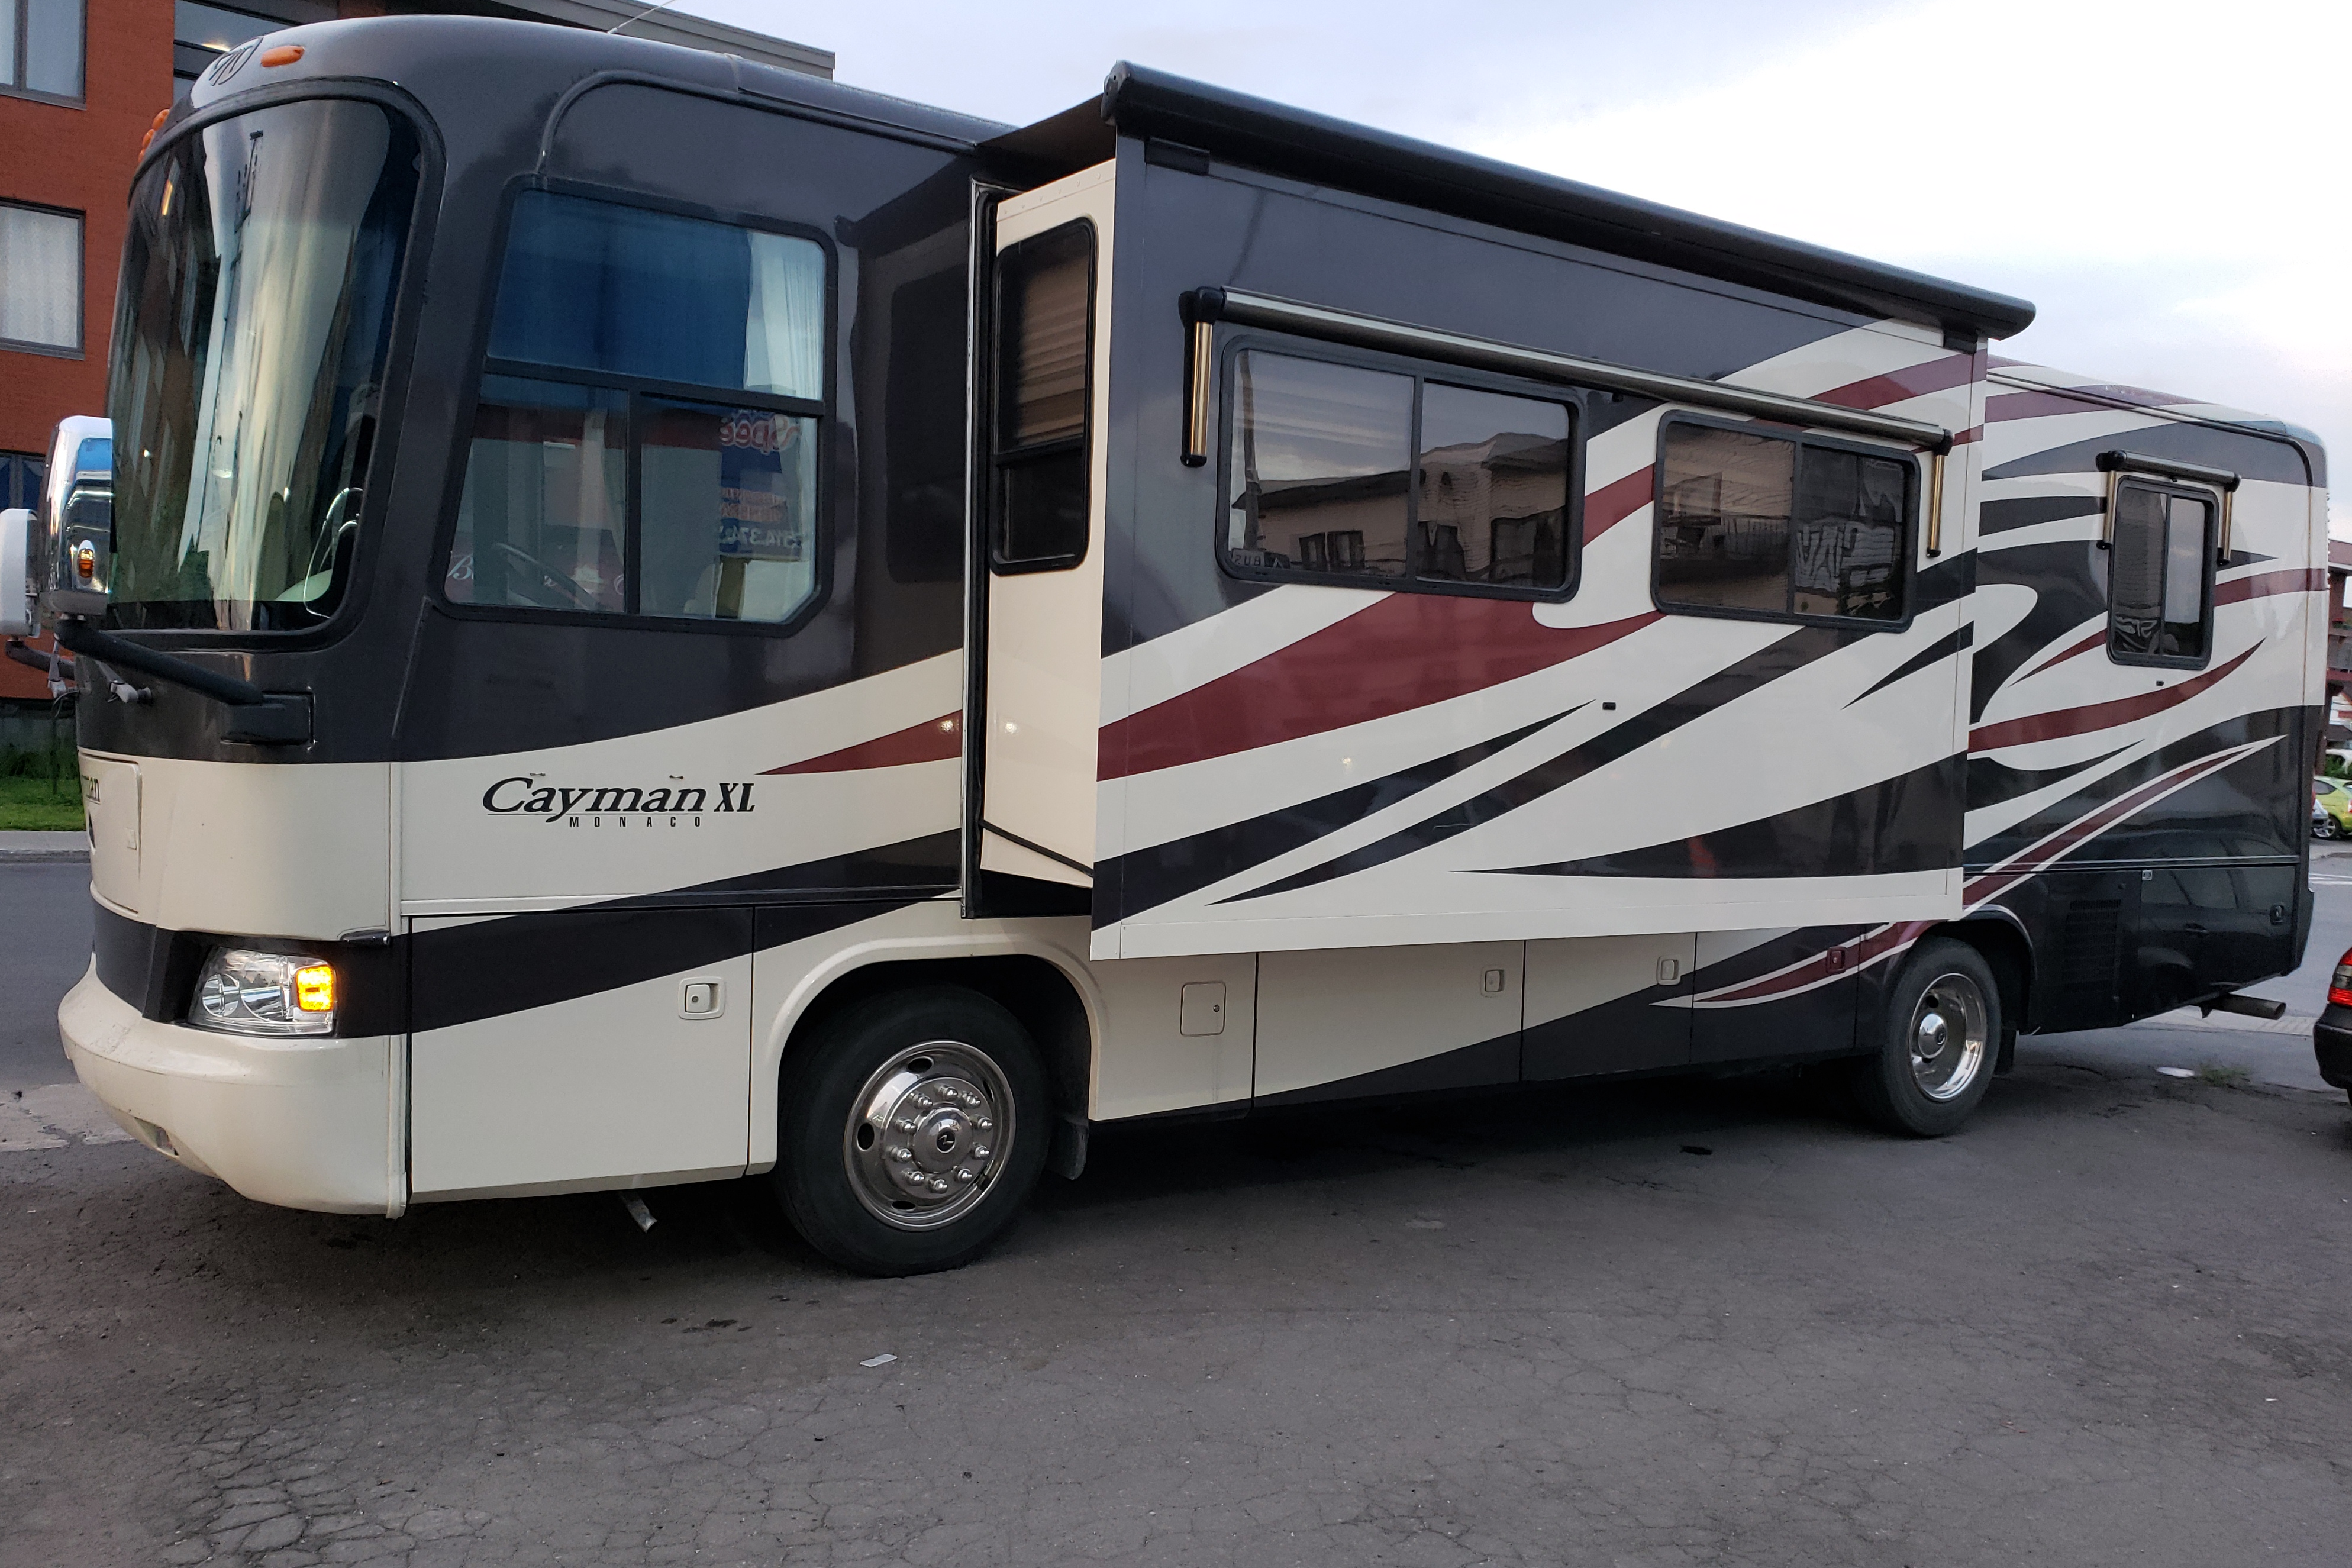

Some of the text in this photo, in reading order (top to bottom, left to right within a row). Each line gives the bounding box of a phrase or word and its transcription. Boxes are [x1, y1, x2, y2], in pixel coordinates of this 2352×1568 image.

[482, 777, 755, 823] Cayman XL
[569, 816, 701, 828] MONACO
